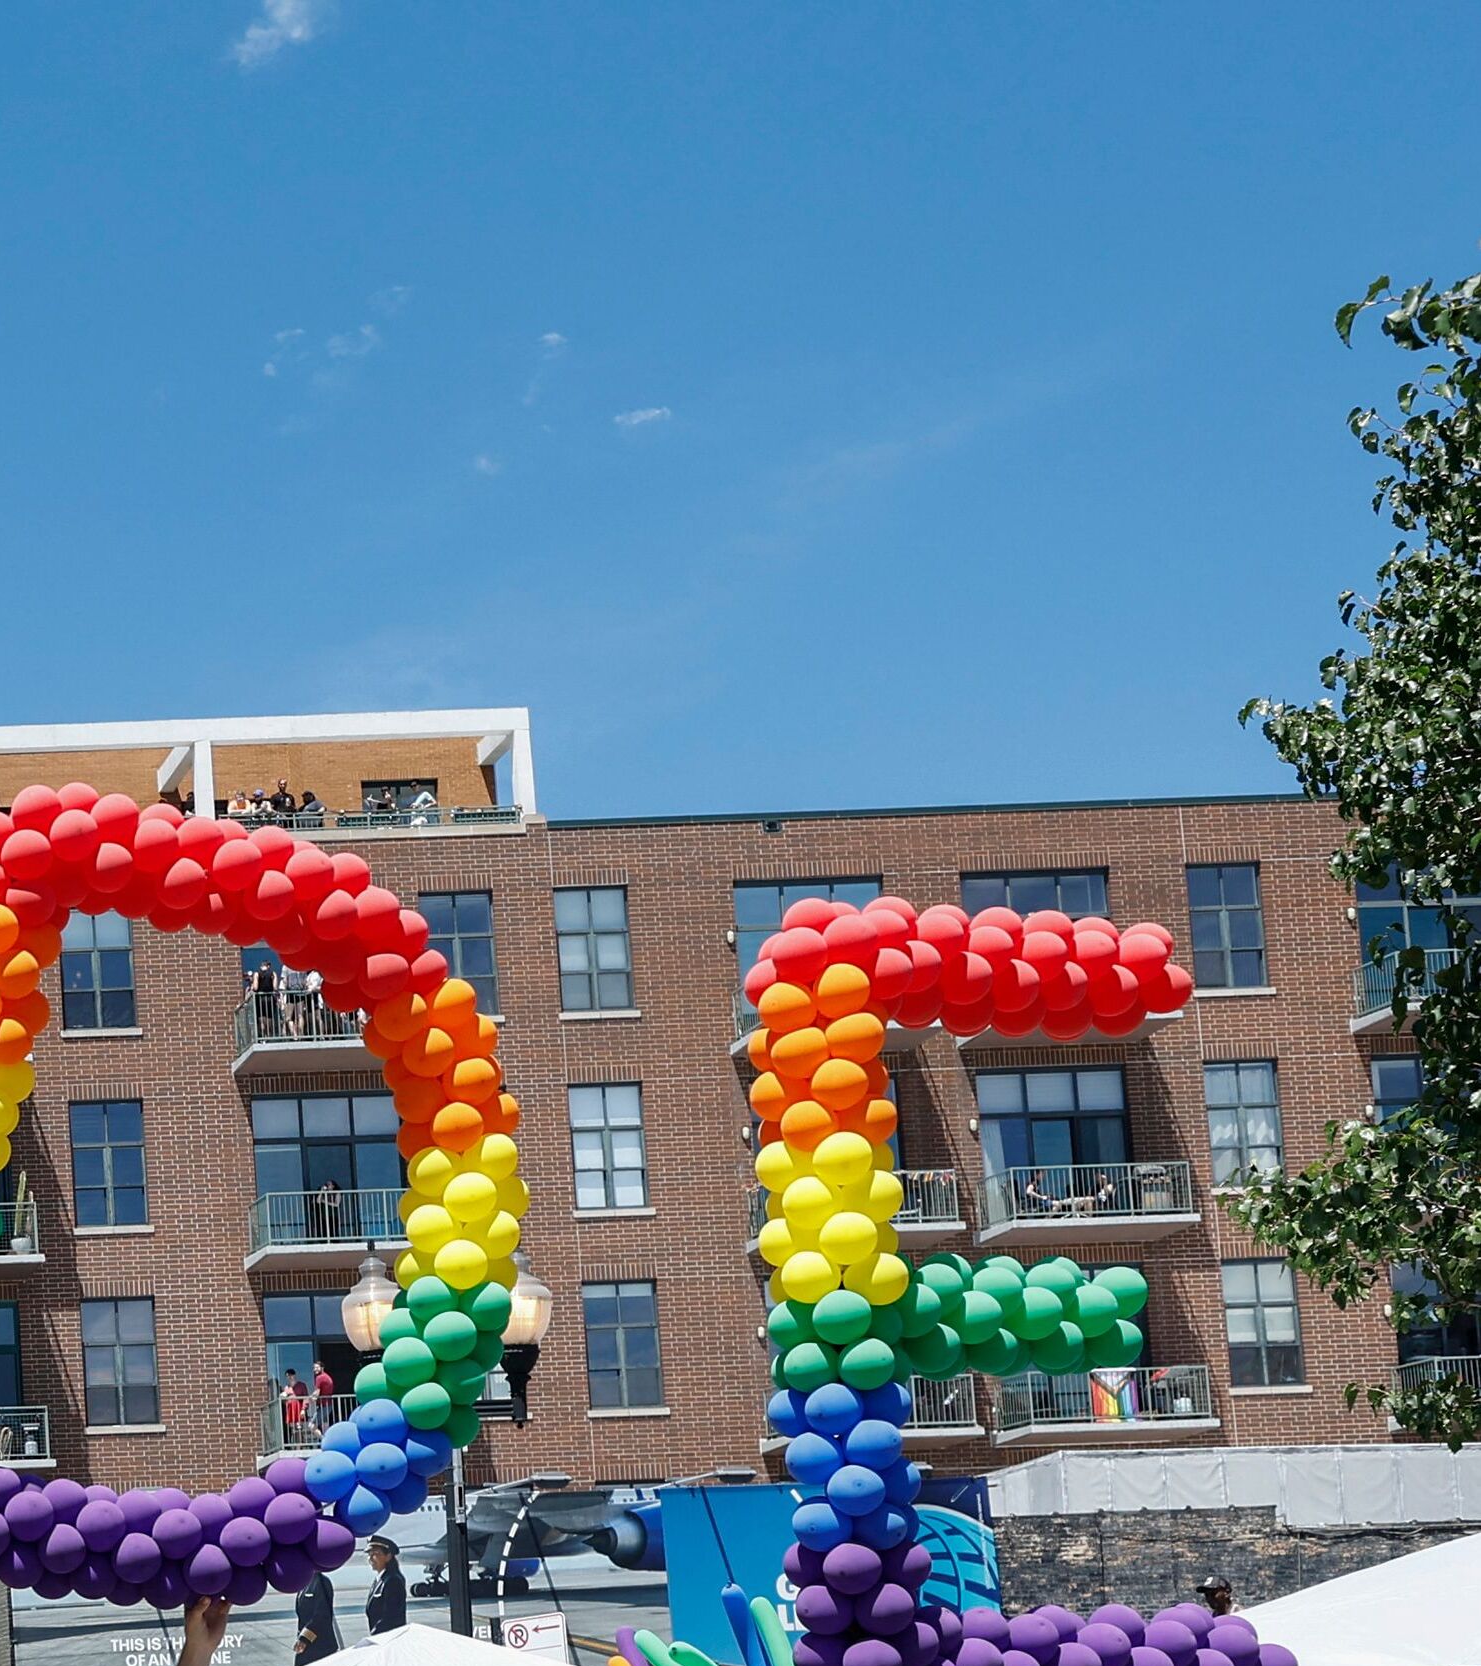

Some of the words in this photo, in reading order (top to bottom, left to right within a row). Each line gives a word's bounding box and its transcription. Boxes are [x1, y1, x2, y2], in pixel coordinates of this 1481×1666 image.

[110, 1638, 144, 1652] THIS
[147, 1637, 161, 1650] IS
[163, 1636, 186, 1650] TH
[148, 1653, 170, 1666] AN
